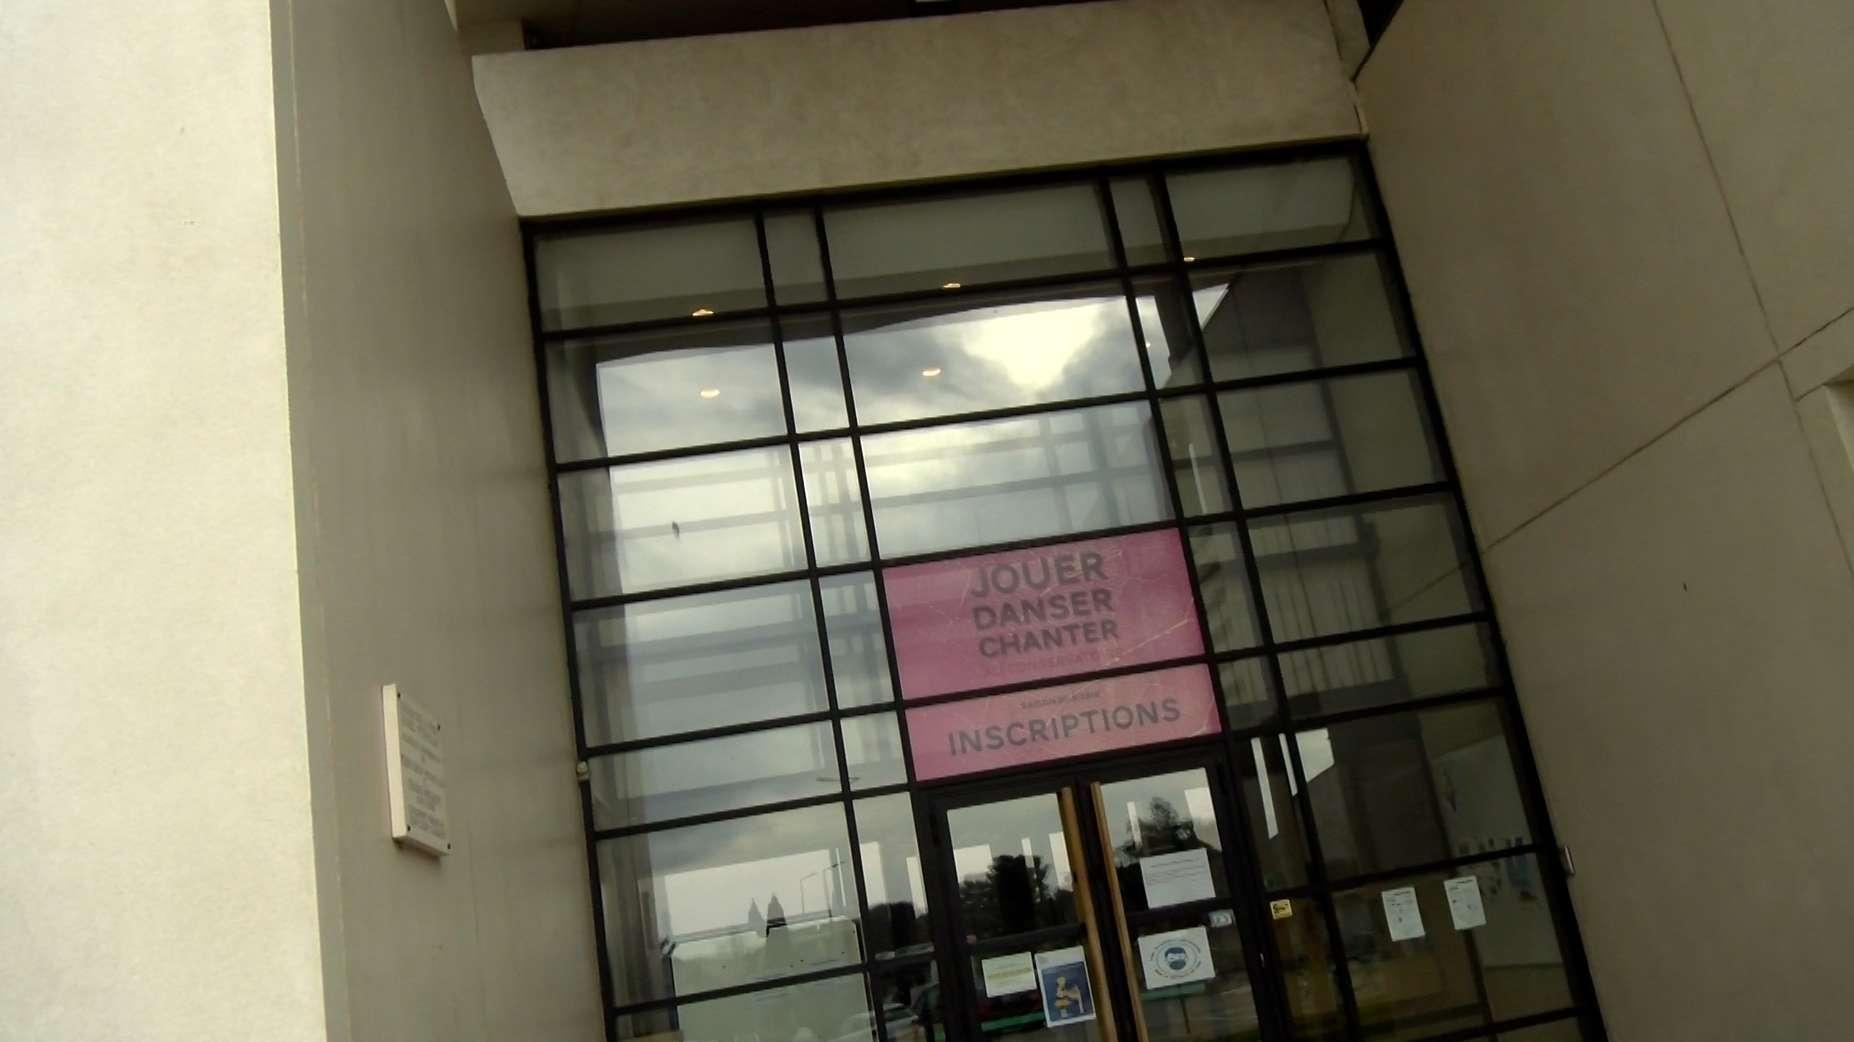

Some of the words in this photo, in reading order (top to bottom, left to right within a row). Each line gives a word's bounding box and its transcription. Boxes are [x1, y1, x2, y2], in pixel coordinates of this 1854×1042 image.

[970, 551, 1109, 598] JOUER
[972, 587, 1115, 630] DANSER
[979, 618, 1119, 658] CHANTER
[949, 698, 1181, 756] INSCRIPTIONS
